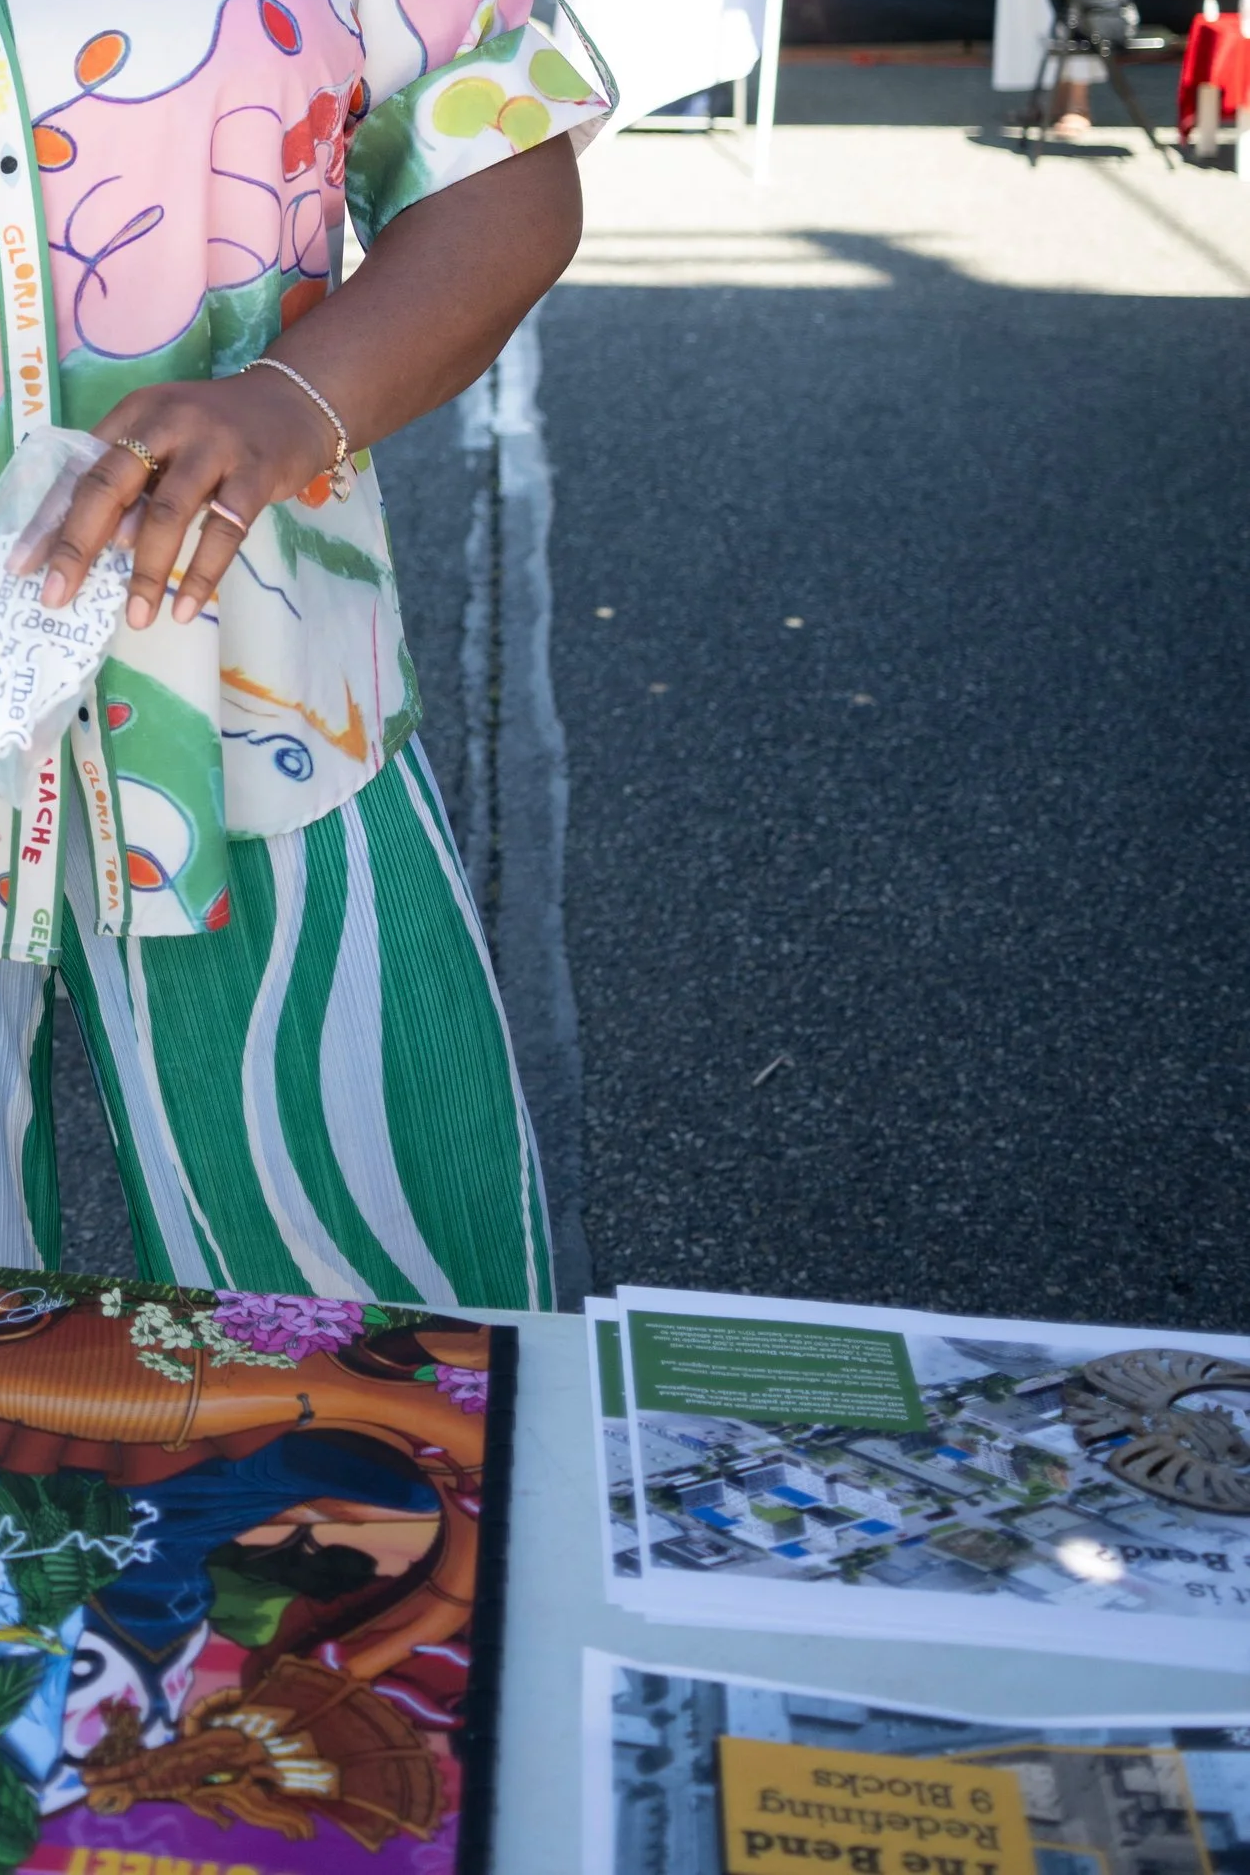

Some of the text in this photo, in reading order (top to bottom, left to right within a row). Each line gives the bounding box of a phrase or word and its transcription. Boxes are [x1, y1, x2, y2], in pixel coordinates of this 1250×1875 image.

[2, 224, 45, 417] GLORIA TODA
[8, 664, 36, 721] The
[21, 757, 57, 865] BACHE
[82, 760, 114, 842] GLORIA
[104, 856, 120, 911] TODA
[757, 1787, 1002, 1852] Redefining
[810, 1768, 994, 1815] 9 Blocks
[741, 1829, 882, 1874] Bend
